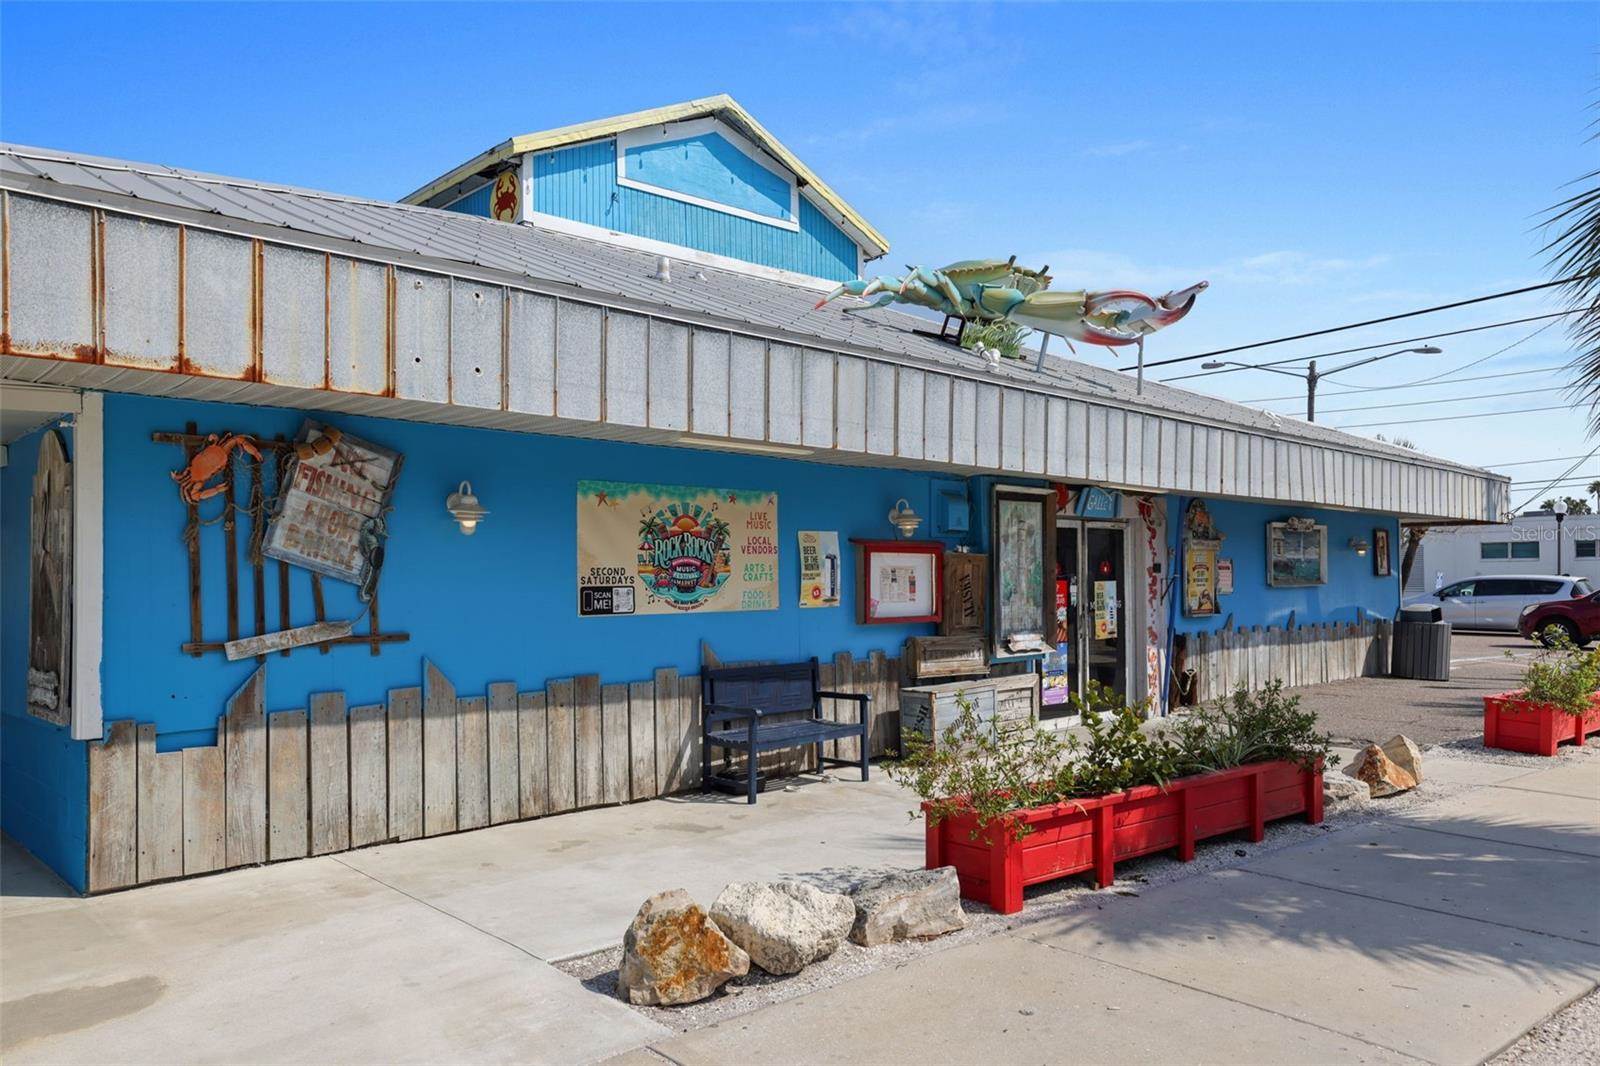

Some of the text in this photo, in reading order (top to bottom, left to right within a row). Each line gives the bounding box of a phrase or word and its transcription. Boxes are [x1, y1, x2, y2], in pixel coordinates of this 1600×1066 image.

[292, 462, 377, 515] FISHING
[750, 512, 768, 521] LIVE
[746, 520, 772, 530] MUSIC
[747, 536, 771, 546] LOCAL
[654, 532, 715, 569] ROCK ROCKS
[741, 545, 778, 555] VENDORS
[803, 545, 816, 555] BEER
[590, 567, 626, 576] SECOND
[744, 563, 765, 573] ARTS
[580, 576, 635, 585] SATURDAYS
[743, 572, 774, 582] CRAFTS
[743, 591, 764, 600] FOOD
[593, 599, 612, 610] ME!
[742, 599, 772, 609] DRINKS
